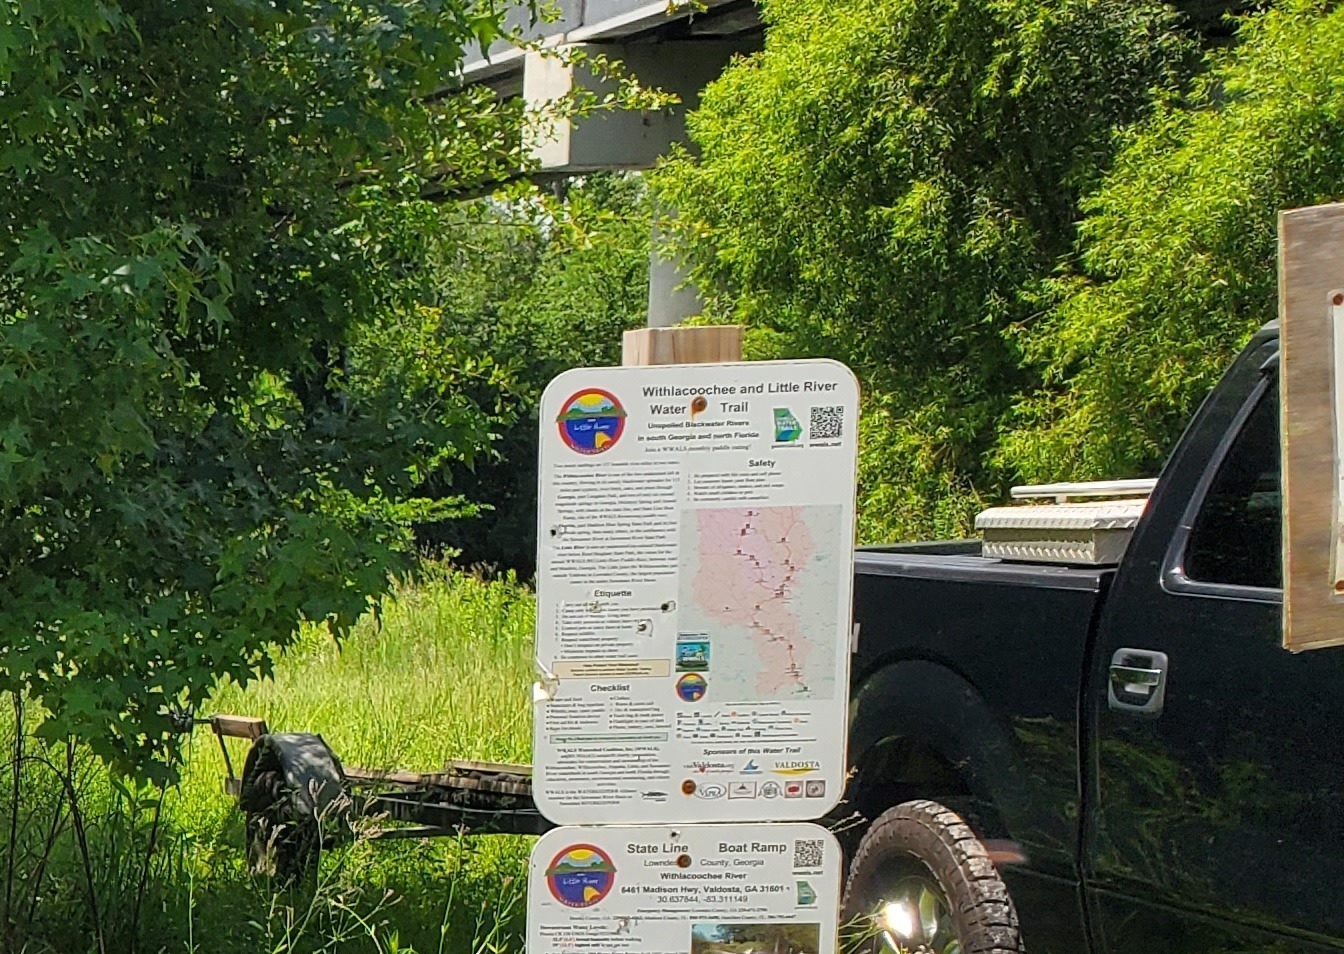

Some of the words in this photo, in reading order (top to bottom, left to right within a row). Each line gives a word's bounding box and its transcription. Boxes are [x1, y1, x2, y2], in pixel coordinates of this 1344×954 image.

[642, 385, 736, 397] Withlacoochee
[739, 384, 764, 394] and
[768, 382, 800, 393] Little
[804, 381, 838, 392] River
[650, 404, 687, 415] Water
[720, 401, 749, 413] Trail
[748, 459, 776, 468] Safety
[594, 589, 632, 598] Etiquette
[590, 684, 630, 692] Checklist
[775, 761, 820, 769] VALDOSTA
[627, 844, 659, 854] State
[662, 843, 689, 853] Line
[718, 842, 748, 853] Boat
[751, 843, 787, 854] Ramp
[643, 859, 679, 867] Lownde
[700, 859, 731, 868] County,
[733, 859, 765, 868] Georgia
[724, 872, 748, 880] River
[680, 886, 701, 894] Hwy,
[703, 885, 743, 894] Valdosta,
[744, 885, 758, 893] GA
